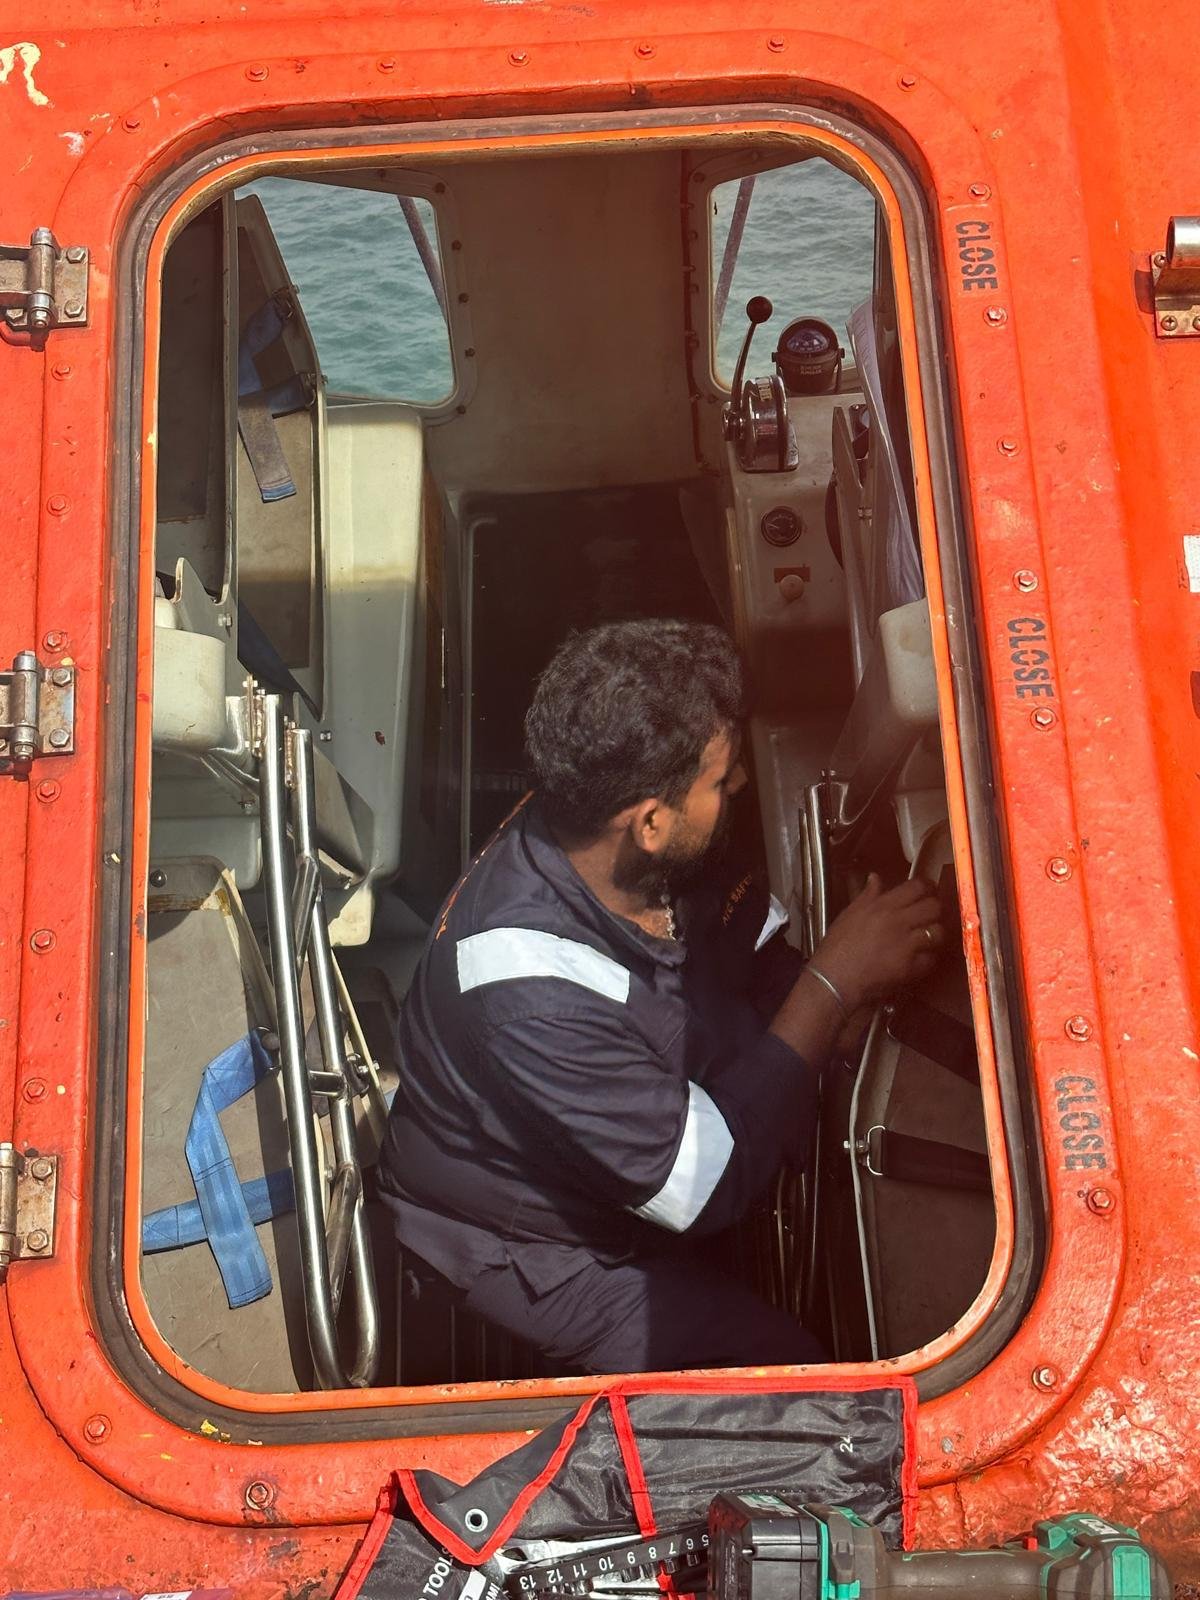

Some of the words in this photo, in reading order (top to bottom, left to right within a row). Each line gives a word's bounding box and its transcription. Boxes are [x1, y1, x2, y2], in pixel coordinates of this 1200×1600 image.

[955, 220, 998, 291] CLOSE
[1007, 617, 1054, 699] CLOSE
[1055, 1076, 1106, 1170] CLOSE
[686, 1538, 694, 1550] 6
[701, 1534, 709, 1546] 5
[648, 1546, 657, 1559] 8
[668, 1542, 677, 1555] 7
[599, 1556, 614, 1571] 10
[627, 1551, 636, 1564] 9
[546, 1568, 563, 1583] 12
[573, 1563, 587, 1578] 11
[520, 1574, 536, 1590] 13
